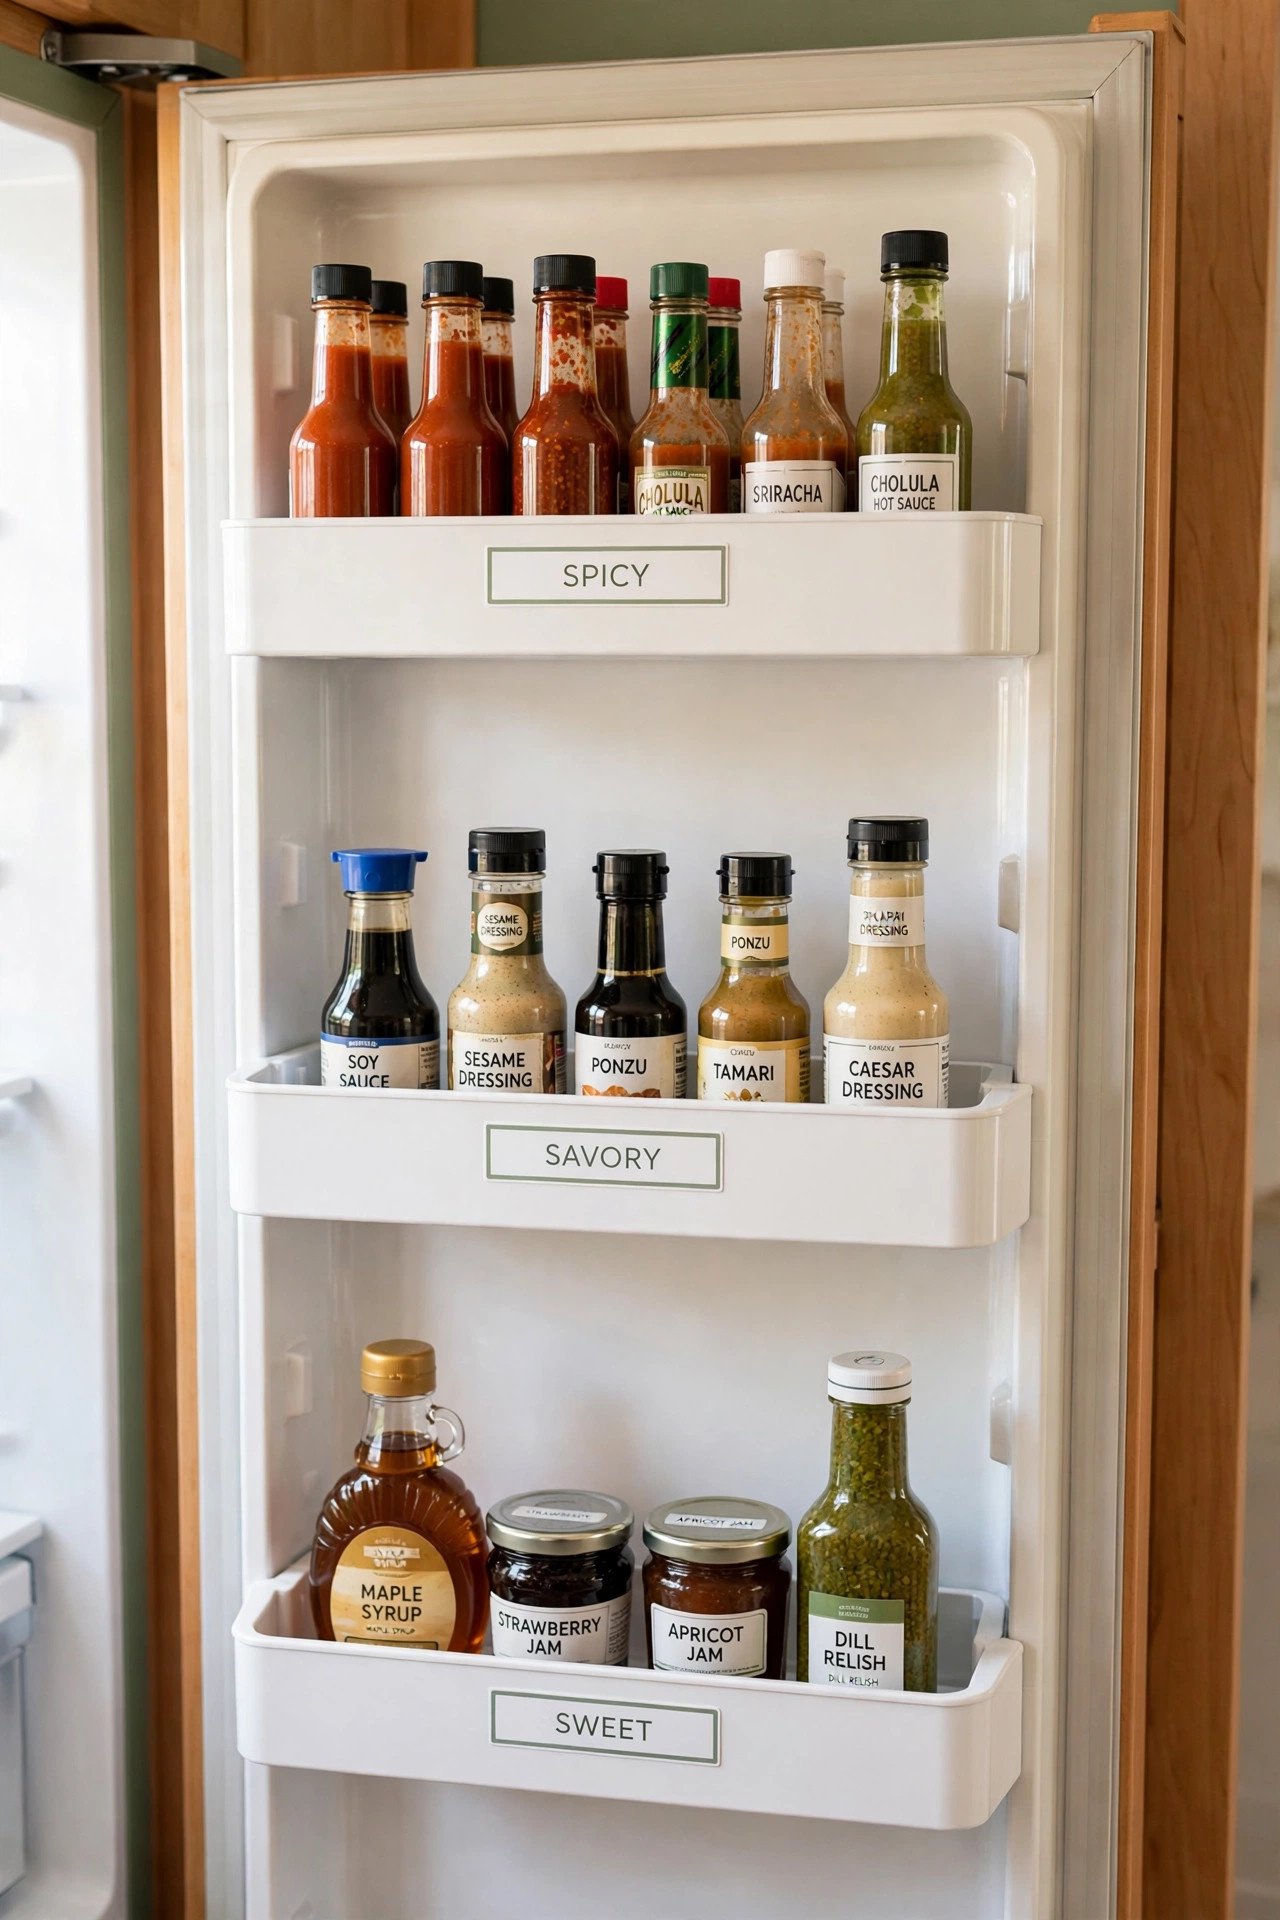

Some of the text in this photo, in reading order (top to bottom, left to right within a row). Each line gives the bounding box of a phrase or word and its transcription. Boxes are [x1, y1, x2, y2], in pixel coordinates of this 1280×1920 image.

[870, 474, 940, 493] CHOLULA
[639, 482, 704, 515] CHOLULA
[753, 484, 823, 503] SRIRACHA
[873, 496, 936, 511] HOT SAUCE
[563, 563, 650, 587] SPICY
[731, 936, 771, 950] PONZU
[348, 1054, 379, 1070] SOY
[464, 1050, 526, 1068] SESAME
[592, 1057, 647, 1075] PONZU
[459, 1069, 533, 1088] DRESSING
[713, 1063, 774, 1081] TAMARI
[849, 1060, 915, 1079] CAESAR
[339, 1073, 390, 1088] SAUCE
[842, 1081, 923, 1100] DRESSING
[545, 1143, 661, 1170] SAVORY
[361, 1584, 422, 1602] MAPLE
[361, 1604, 422, 1622] SYRUP
[498, 1611, 602, 1636] STRAWBERRY
[668, 1623, 744, 1643] APRICOT
[526, 1639, 562, 1655] JAM
[835, 1631, 875, 1650] DILL
[687, 1646, 723, 1662] JAM
[824, 1649, 886, 1671] RELISH
[555, 1712, 653, 1741] SWEET
